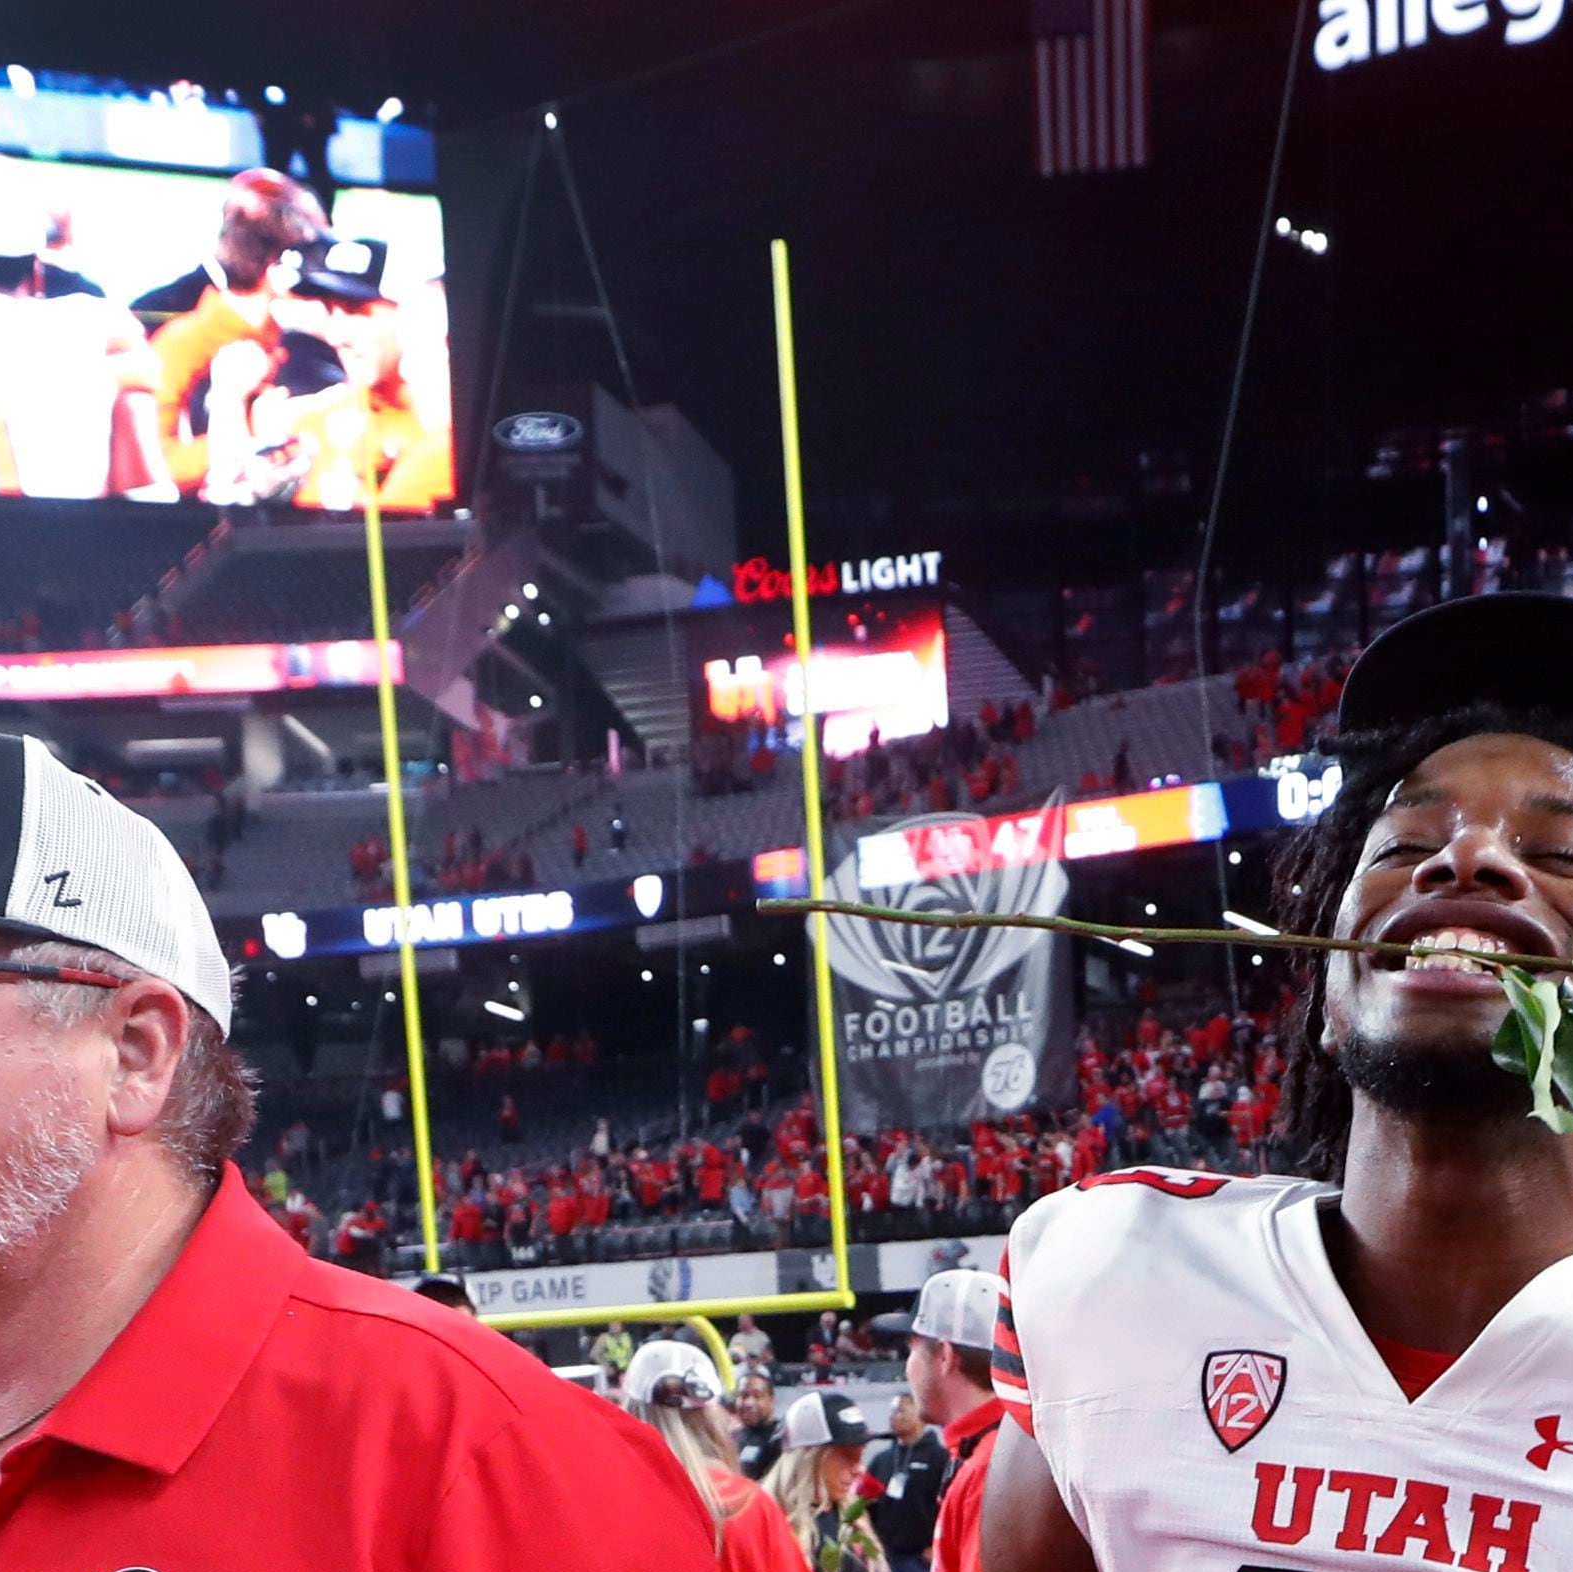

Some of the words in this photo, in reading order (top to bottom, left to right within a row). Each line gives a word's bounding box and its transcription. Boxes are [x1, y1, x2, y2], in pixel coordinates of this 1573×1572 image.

[841, 551, 942, 594] LIGHT
[844, 993, 1032, 1042] FOOTBALL
[512, 1274, 586, 1304] GAME
[1206, 1352, 1283, 1413] PAC
[1216, 1391, 1260, 1430] 12
